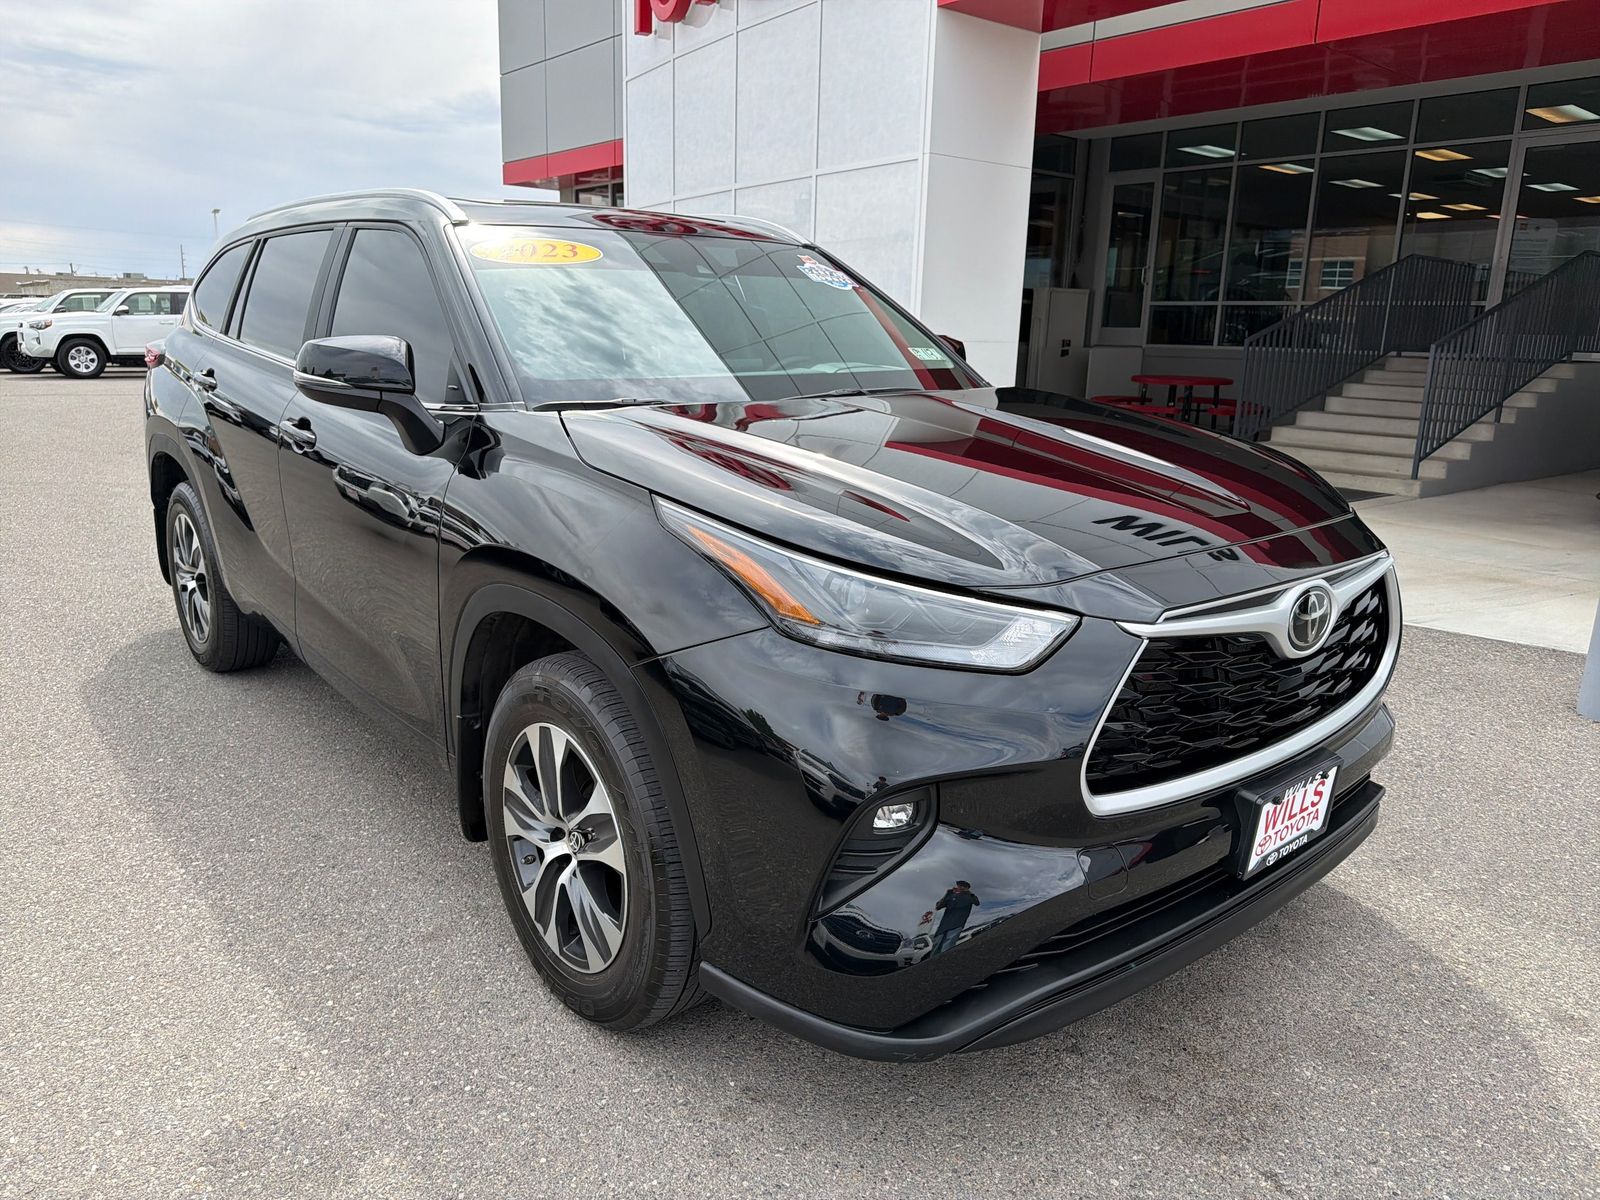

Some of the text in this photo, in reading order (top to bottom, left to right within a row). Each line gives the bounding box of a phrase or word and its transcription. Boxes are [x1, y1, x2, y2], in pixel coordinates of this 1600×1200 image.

[1264, 779, 1326, 835] WILLS
[1273, 808, 1319, 846] TOYOTA
[1279, 834, 1308, 859] TOYOTA
